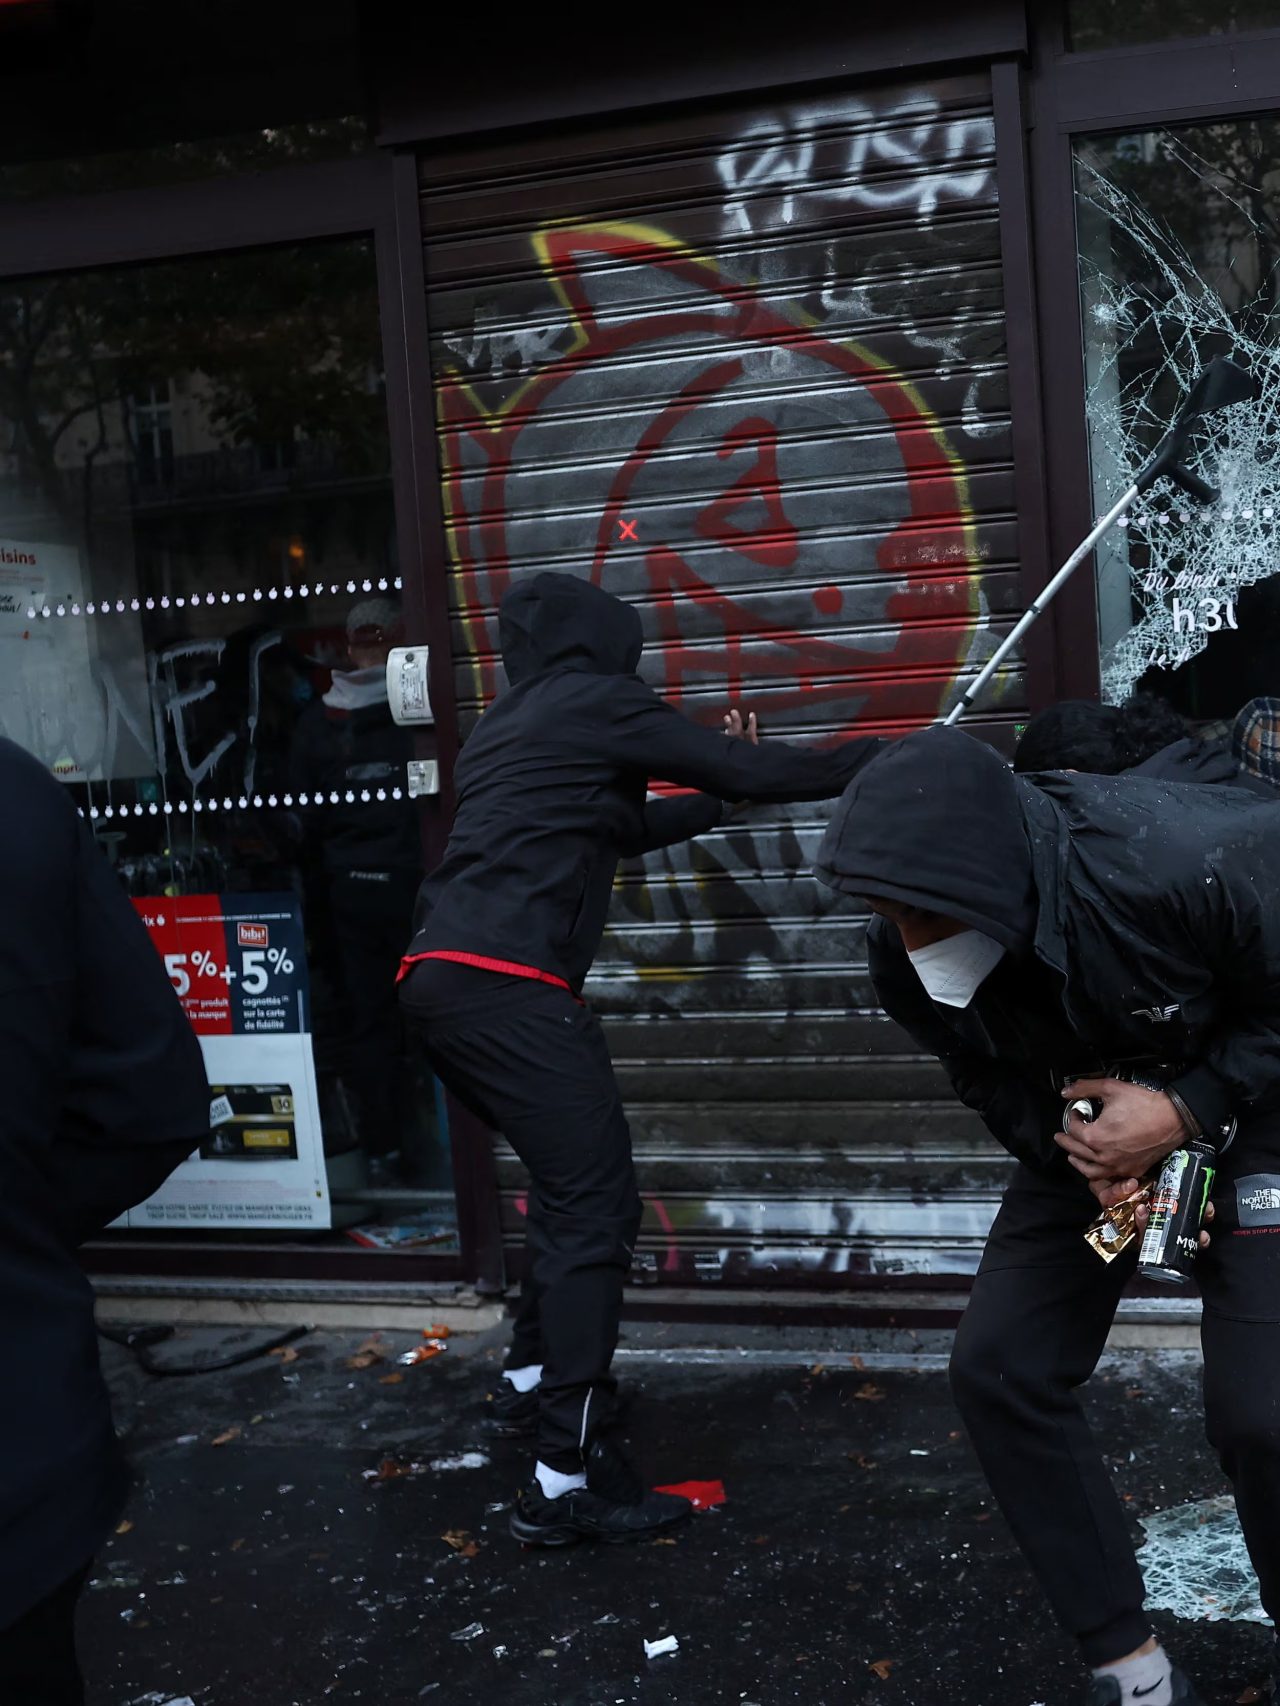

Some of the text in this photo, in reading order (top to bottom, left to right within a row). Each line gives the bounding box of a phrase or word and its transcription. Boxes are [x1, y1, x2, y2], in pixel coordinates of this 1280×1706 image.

[240, 947, 295, 996] 5%
[256, 1008, 265, 1018] la
[265, 1008, 286, 1018] carte
[244, 1021, 255, 1031] de
[1253, 1188, 1271, 1197] THE
[1241, 1195, 1271, 1206] NORTH
[1250, 1201, 1272, 1211] FACE
